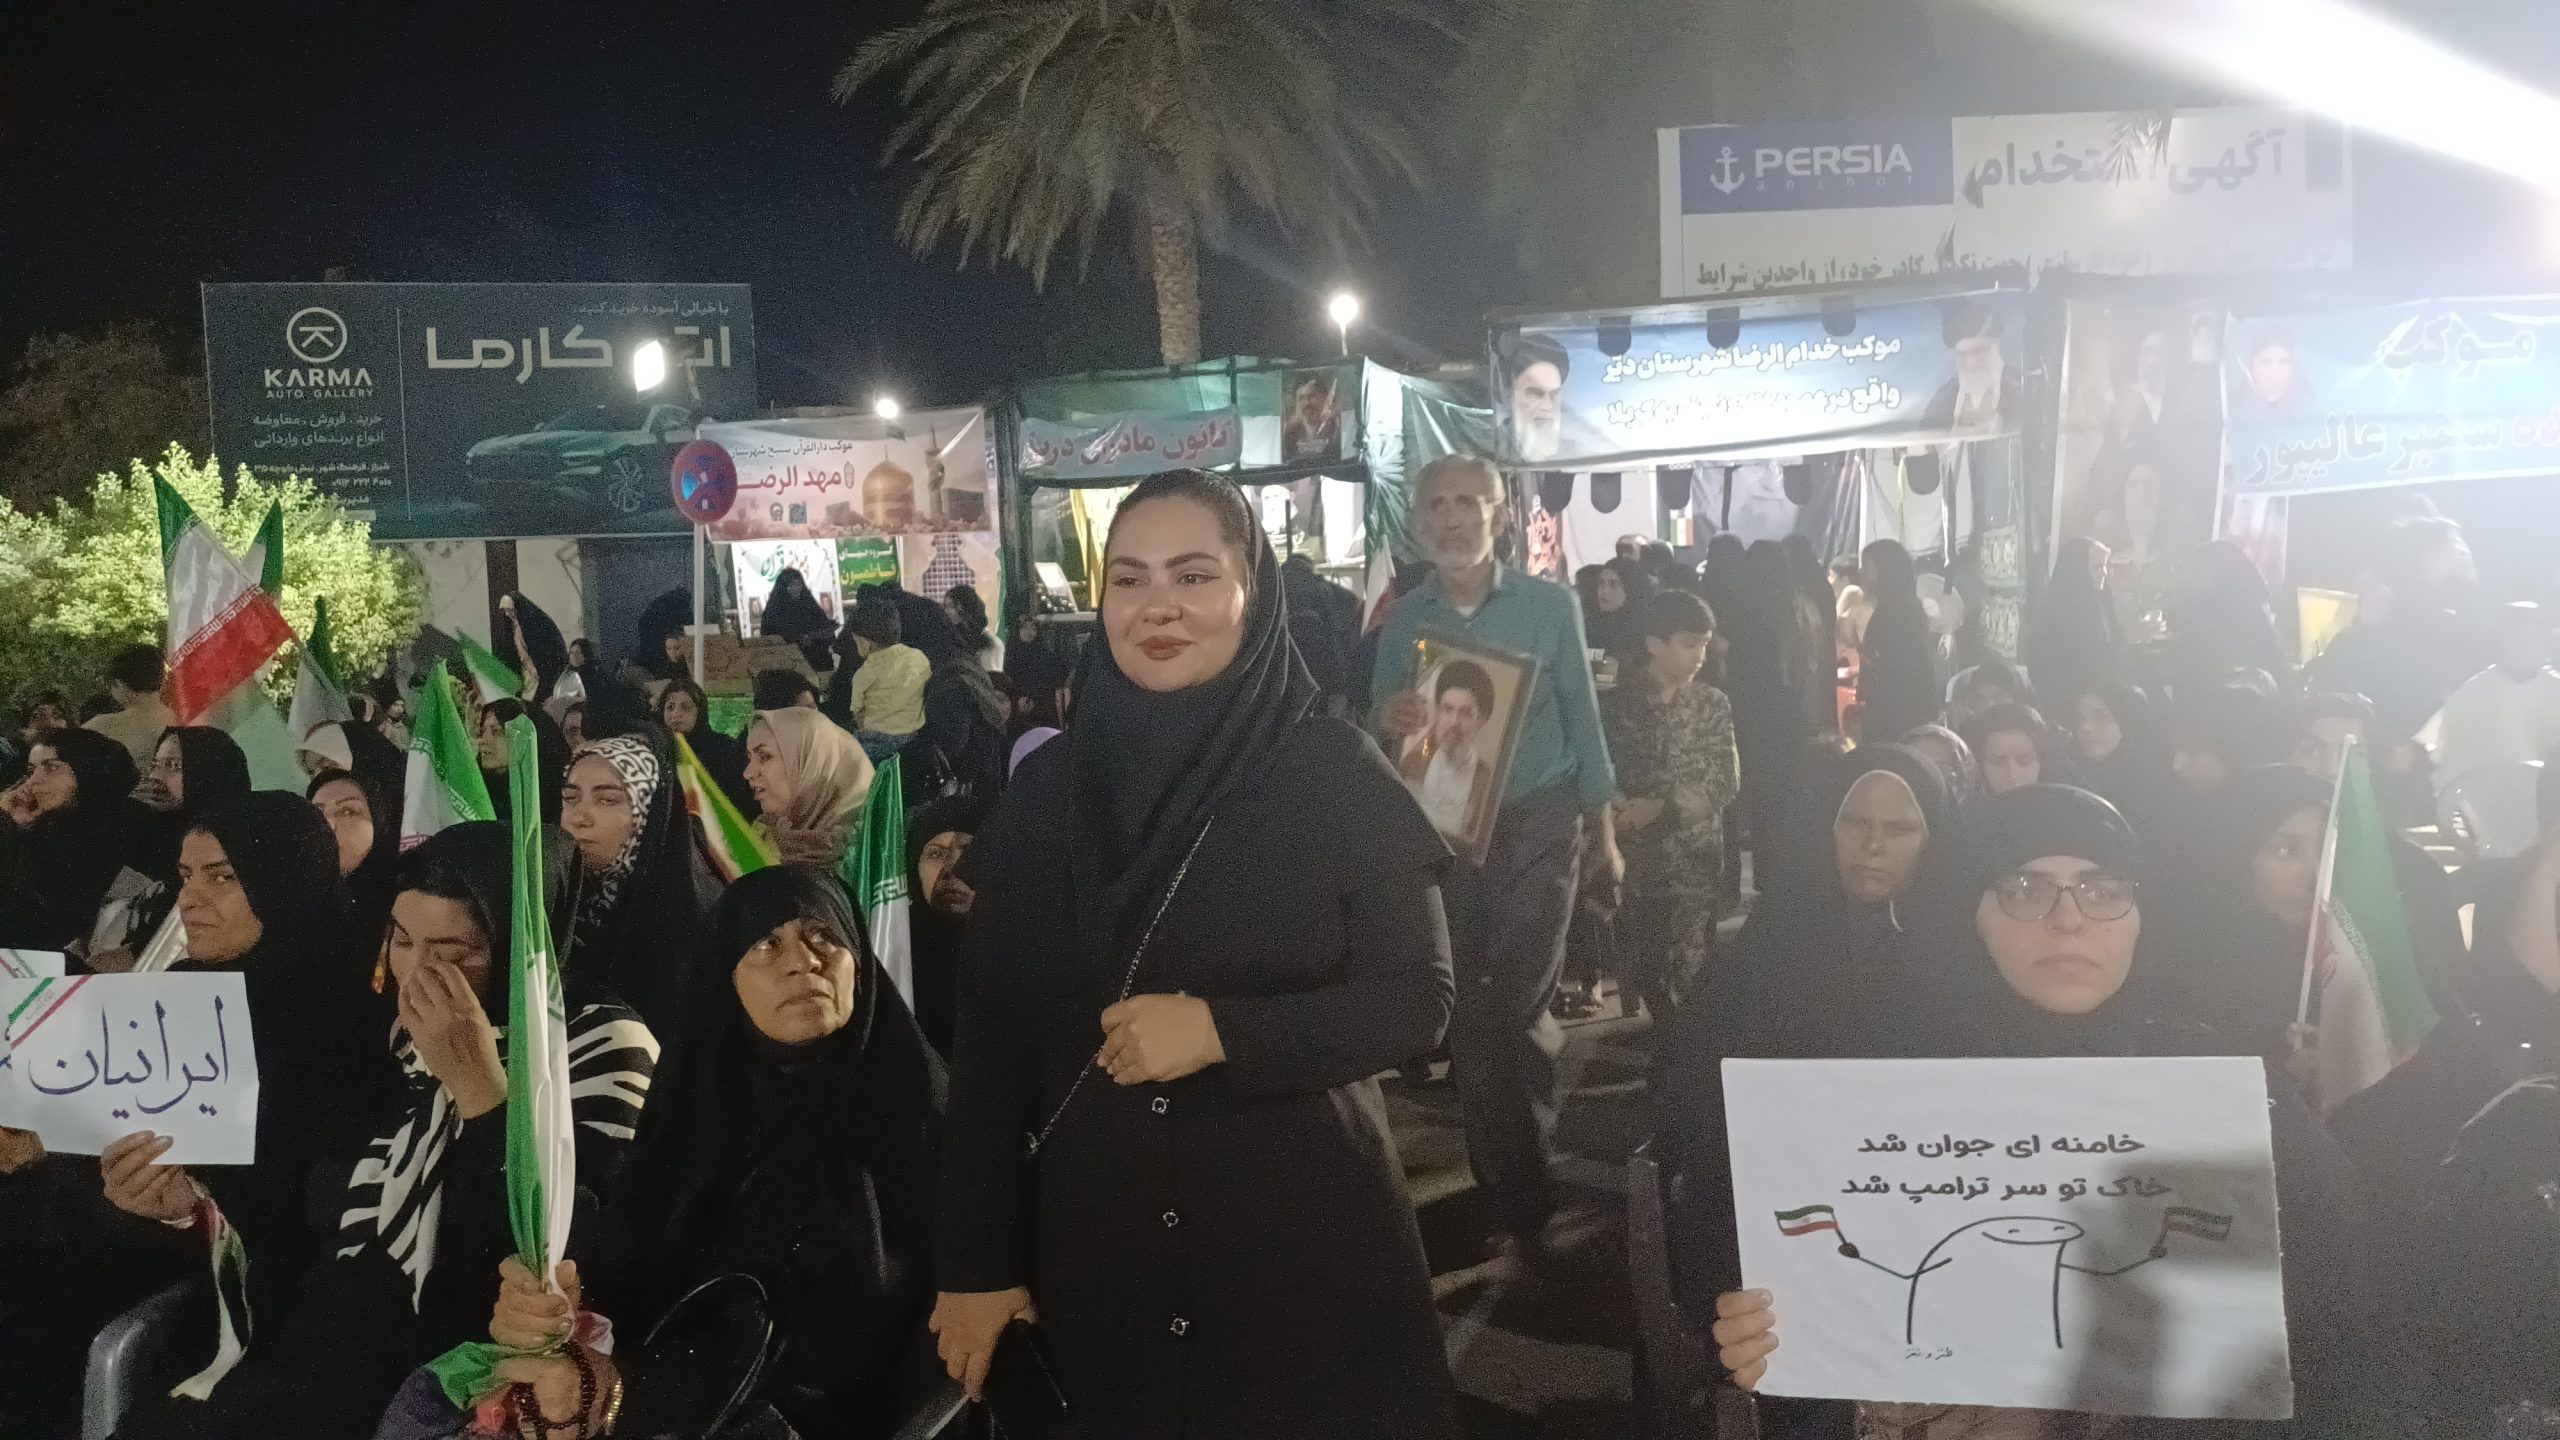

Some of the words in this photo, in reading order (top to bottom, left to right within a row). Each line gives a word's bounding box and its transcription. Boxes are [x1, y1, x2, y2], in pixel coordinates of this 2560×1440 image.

[1754, 143, 1913, 178] PERSIA
[2168, 128, 2287, 194] آگهی
[426, 324, 613, 385] کارما
[1732, 341, 1784, 373] الرضا
[1785, 337, 1840, 370] خدام
[1841, 334, 1902, 365] موکب
[2380, 311, 2537, 382] موکب
[263, 367, 373, 388] KARMA
[1637, 348, 1732, 380] شهرستان
[265, 389, 305, 399] AUTO
[312, 388, 375, 399] GALLERY
[1852, 376, 1901, 414] واقع
[2242, 409, 2387, 487] عالیپور
[803, 468, 843, 494] مهد
[27, 994, 230, 1120] ایرانیان
[1857, 1133, 1907, 1153] شد
[1915, 1134, 1996, 1159] جوان
[2004, 1134, 2040, 1159] ای
[2050, 1133, 2146, 1154] خامنه
[1840, 1175, 1891, 1196] شد
[1899, 1175, 1991, 1204] ترامپ
[1999, 1184, 2048, 1202] سر
[2057, 1177, 2088, 1203] تو
[2096, 1174, 2174, 1198] خاک
